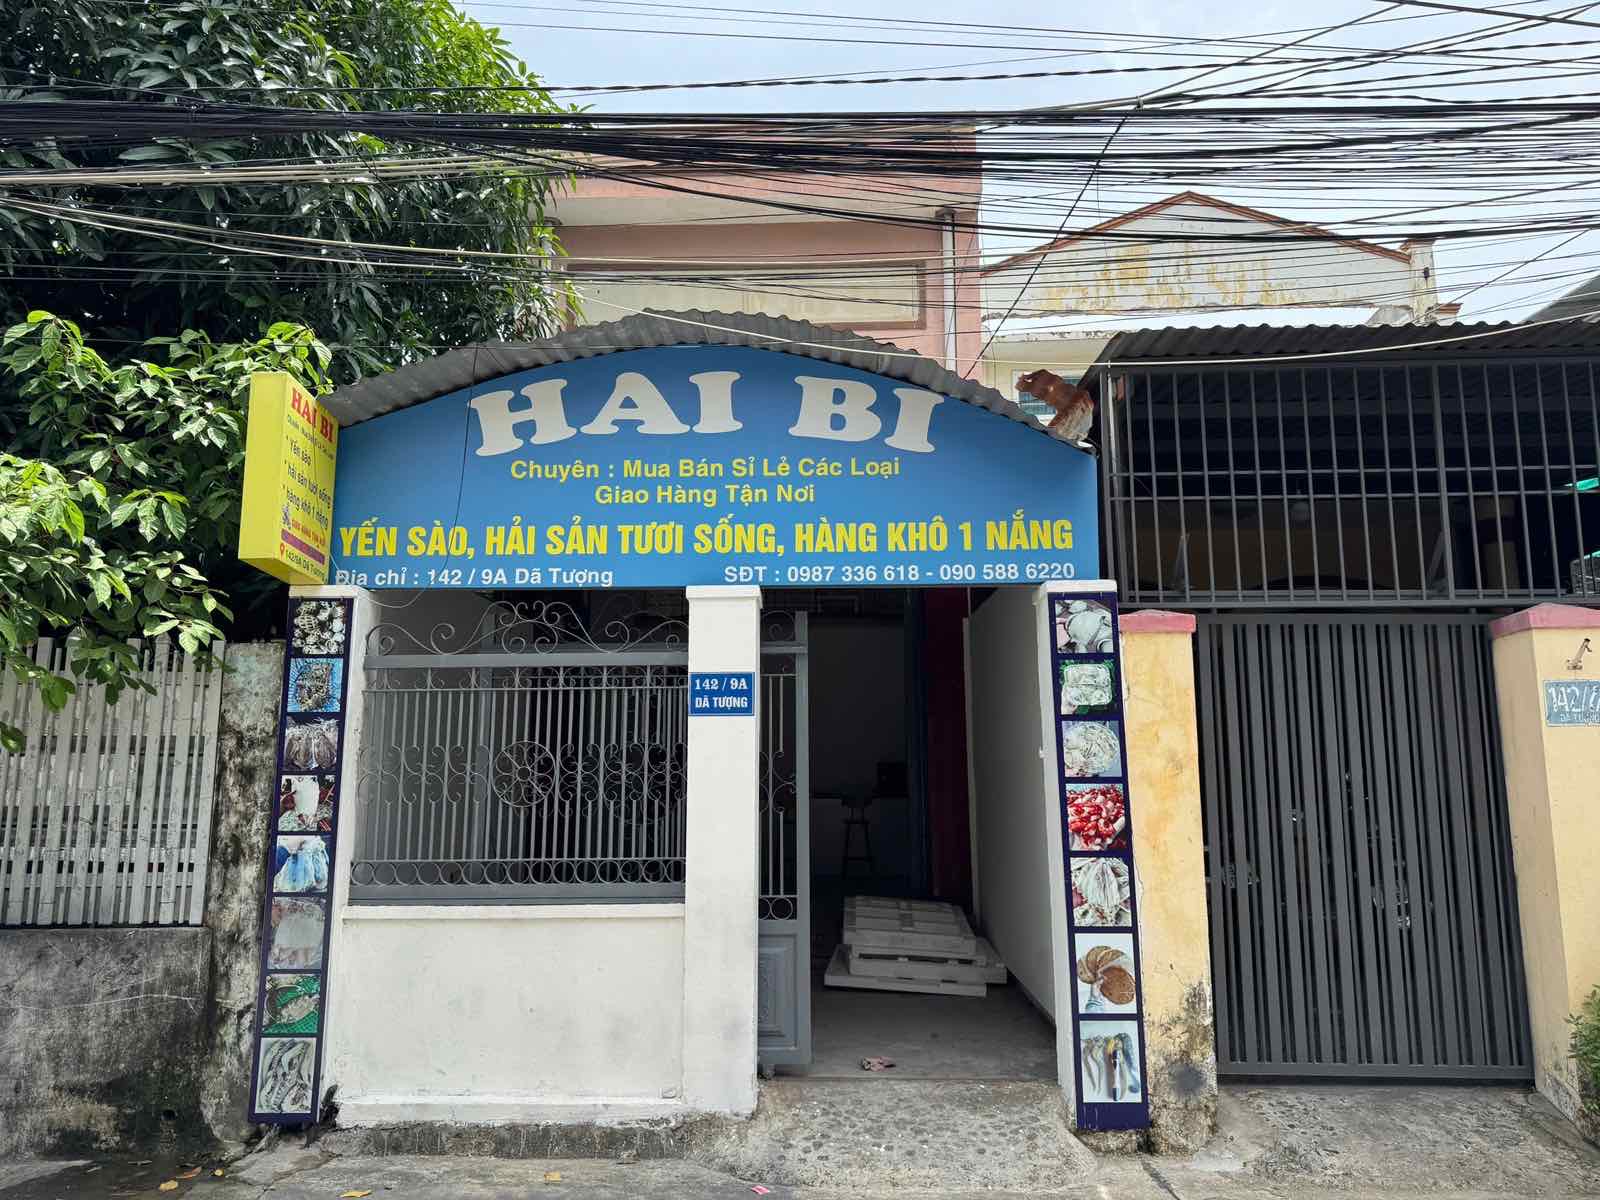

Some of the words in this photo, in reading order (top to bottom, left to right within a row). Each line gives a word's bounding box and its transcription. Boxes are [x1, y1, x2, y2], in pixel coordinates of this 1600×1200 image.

[291, 387, 317, 428] HAI
[320, 414, 336, 443] BI
[468, 371, 744, 457] HAI
[788, 375, 945, 453] BI
[510, 459, 600, 483] Chuyên
[623, 459, 671, 477] Mua
[679, 458, 724, 477] Bán
[731, 456, 756, 477] Sỉ
[762, 455, 791, 477] Lẻ
[798, 457, 843, 477] Các
[850, 456, 901, 479] Loại
[594, 485, 649, 505] Giao
[656, 484, 718, 508] Hàng
[724, 484, 768, 507] Tận
[776, 484, 816, 503] Nơi
[339, 516, 398, 557] YẾN
[406, 520, 475, 560] SÀO,
[485, 515, 536, 556] HẢI
[545, 515, 608, 556] SẢN
[617, 522, 684, 555] TƯƠI
[693, 513, 785, 557] SỐNG,
[794, 516, 878, 553] HÀNG
[887, 515, 948, 552] KHÔ
[958, 522, 973, 551] 1
[985, 509, 1074, 551] NẮNG
[374, 567, 407, 586] chỉ
[427, 569, 462, 585] 142
[481, 568, 508, 585] 9A
[515, 568, 542, 585] Dã
[548, 567, 613, 588] Tượng
[724, 566, 767, 582] SĐT
[787, 566, 835, 582] 0987
[841, 565, 877, 582] 336
[884, 565, 920, 581] 618
[939, 564, 976, 581] 090
[983, 563, 1019, 580] 588
[1025, 562, 1075, 580] 6220
[695, 679, 719, 691] 142
[730, 678, 749, 690] 9A
[695, 695, 710, 709] DÃ
[713, 696, 748, 710] TƯỢNG
